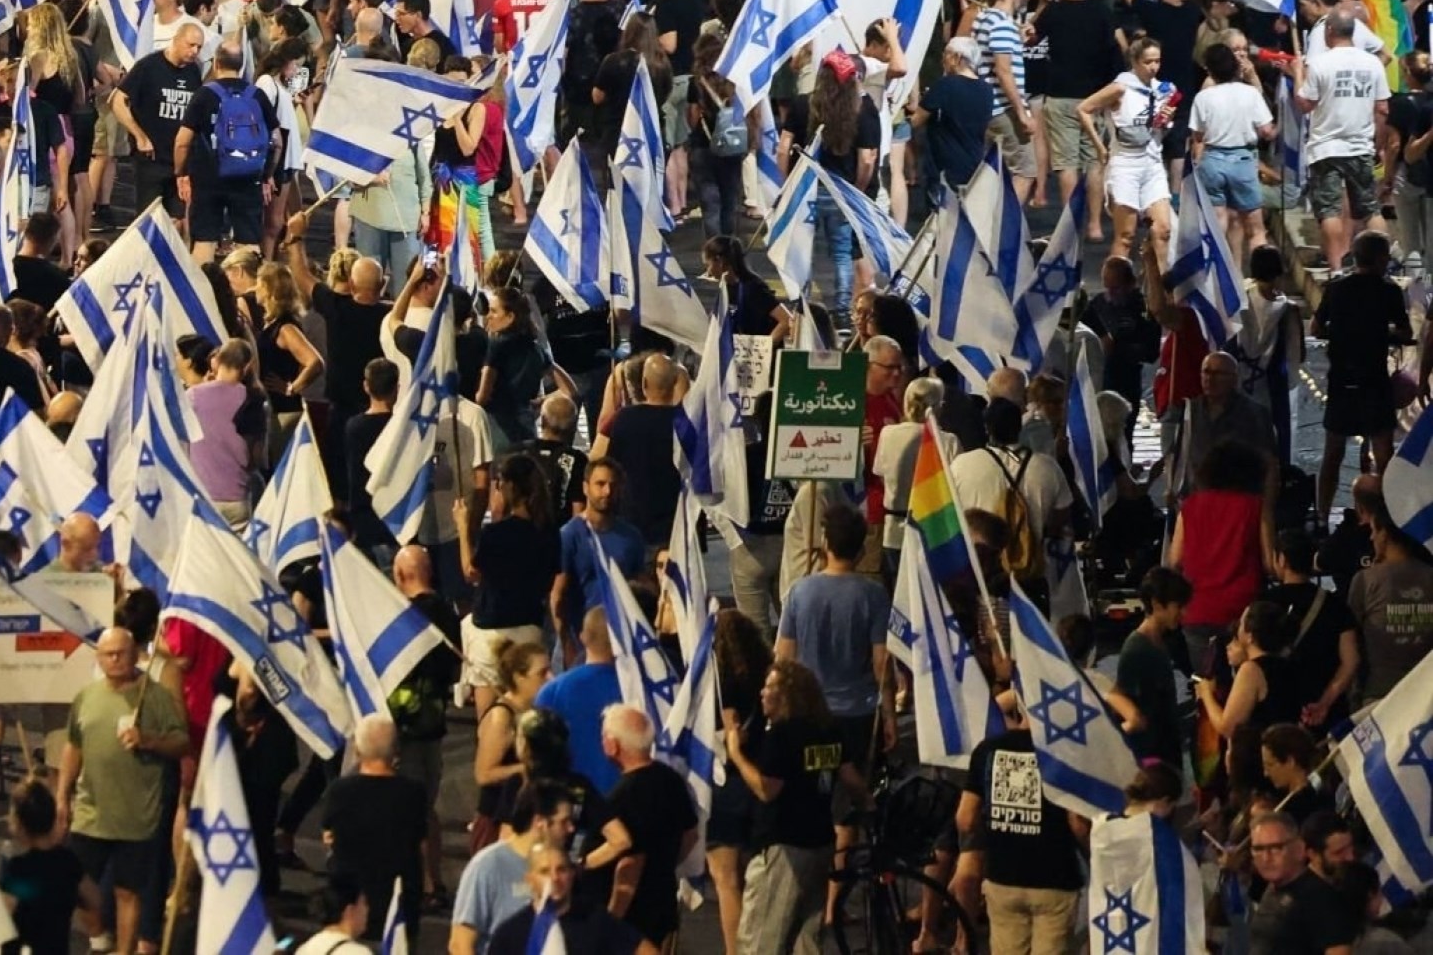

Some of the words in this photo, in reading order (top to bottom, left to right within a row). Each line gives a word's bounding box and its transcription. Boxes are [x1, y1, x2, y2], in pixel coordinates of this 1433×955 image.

[161, 88, 194, 104] ופשי
[783, 392, 857, 415] ديكتاتورية
[991, 806, 1042, 823] סורקים
